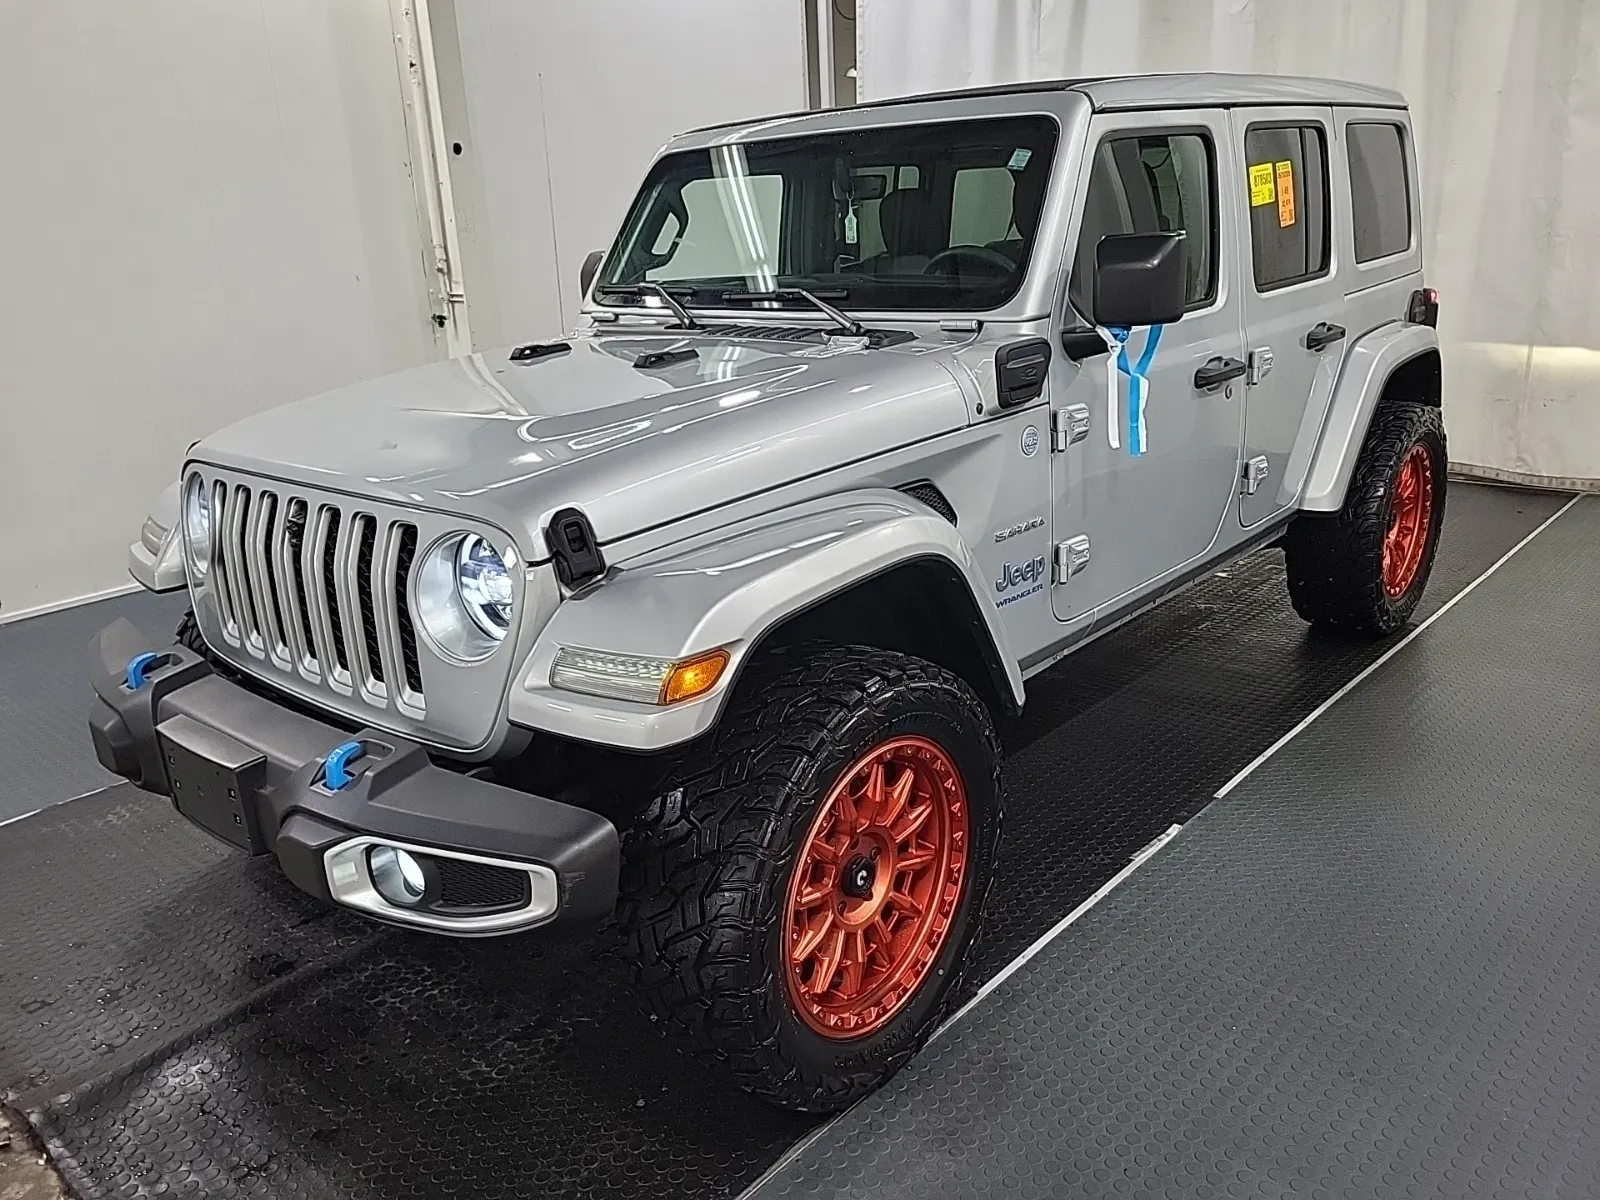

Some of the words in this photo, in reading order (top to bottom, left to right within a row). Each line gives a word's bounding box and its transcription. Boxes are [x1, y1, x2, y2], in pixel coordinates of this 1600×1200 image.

[994, 516, 1045, 543] SAHARA
[995, 555, 1046, 592] Jeep
[995, 583, 1043, 609] WRANGLER
